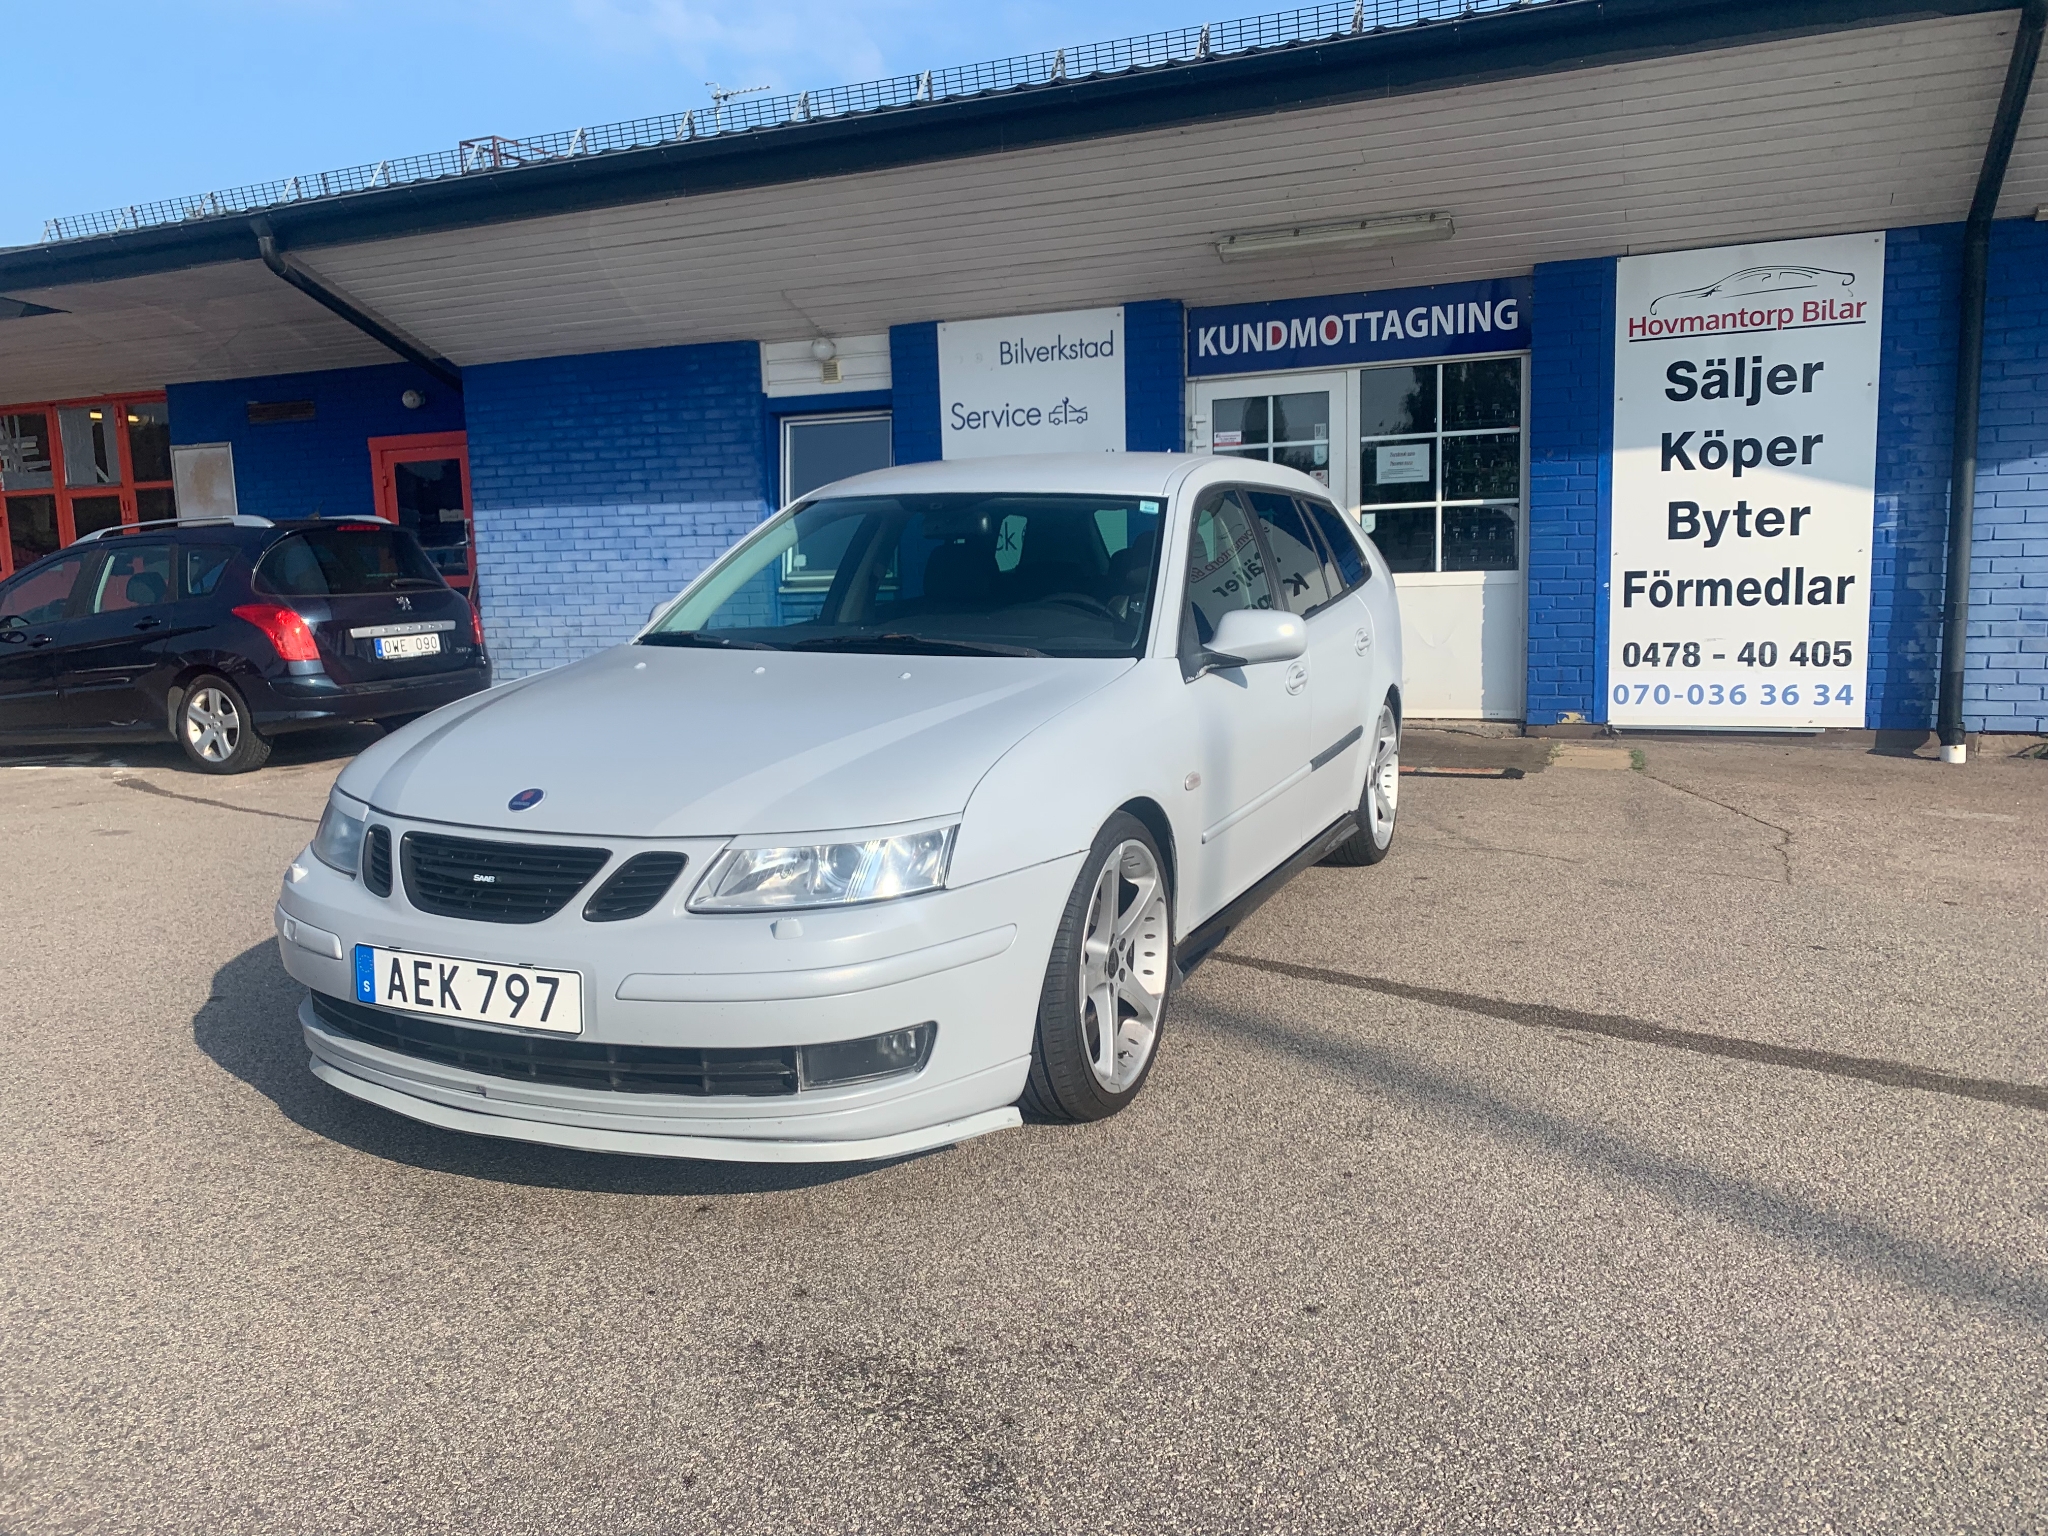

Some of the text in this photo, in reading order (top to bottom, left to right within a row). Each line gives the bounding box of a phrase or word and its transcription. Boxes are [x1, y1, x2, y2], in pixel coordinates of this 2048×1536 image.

[1198, 298, 1519, 357] KUNDMOTTAGNING
[1628, 298, 1868, 338] Hovmantorp Bilar
[1000, 329, 1114, 366] Bilverkstad
[1664, 355, 1825, 407] Säljer
[950, 402, 1042, 431] Service
[1660, 428, 1824, 478] Köper
[1667, 500, 1812, 548] Byter
[1623, 566, 1856, 608] Förmedlar
[384, 639, 408, 653] OWE
[415, 636, 438, 651] 090
[1622, 641, 1701, 668] 0478
[1737, 641, 1778, 668] 40
[1789, 640, 1853, 668] 405
[1612, 683, 1854, 706] 070-036 36 34
[473, 874, 495, 883] SAAB
[363, 957, 560, 1023] S AEK 797
